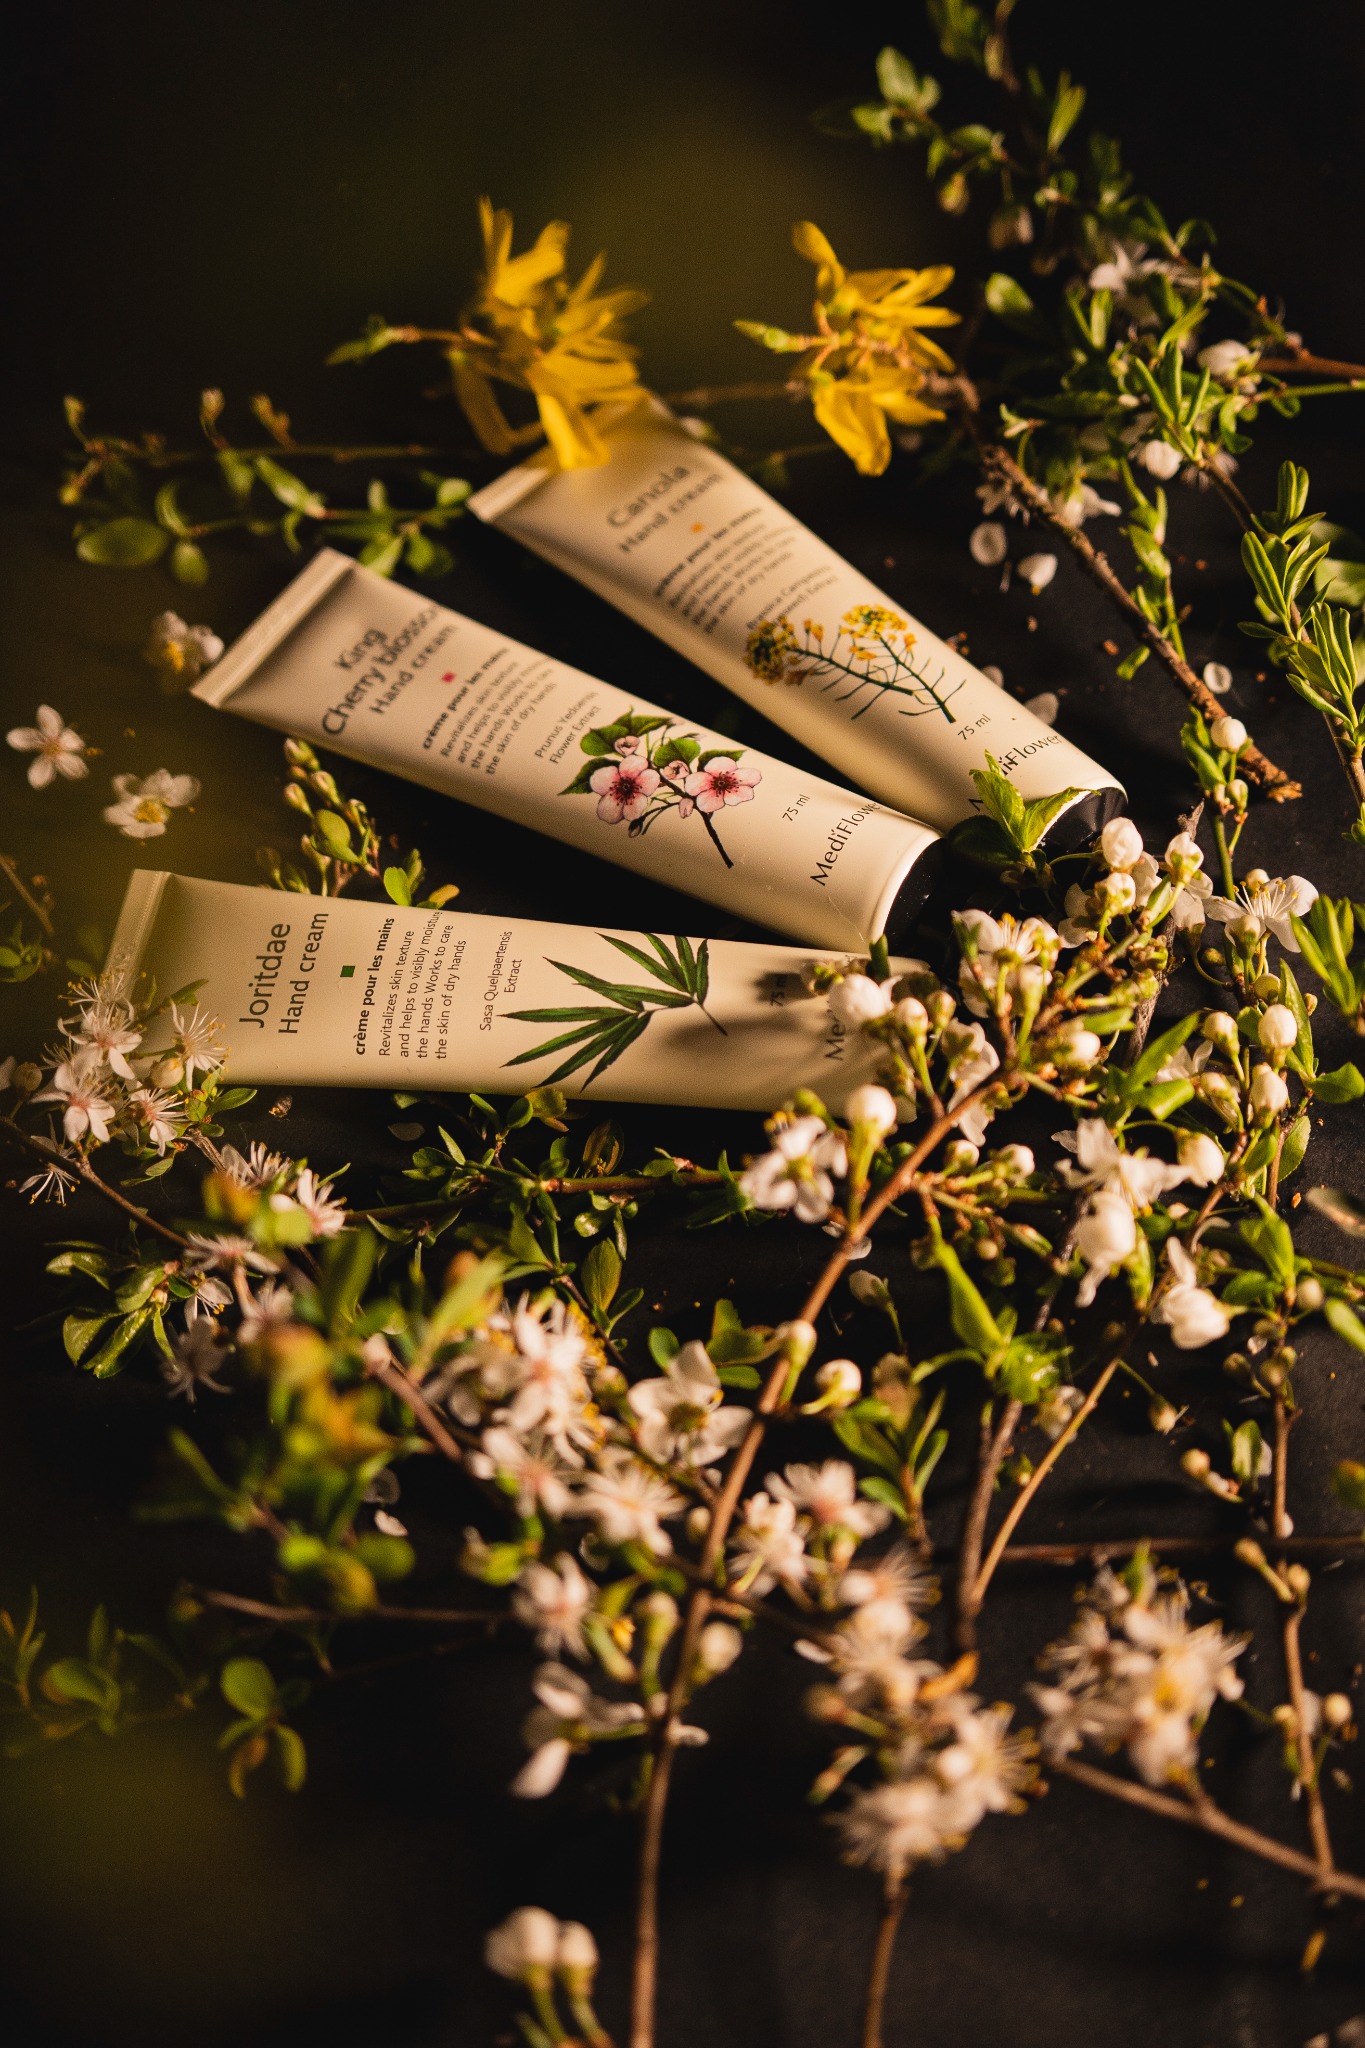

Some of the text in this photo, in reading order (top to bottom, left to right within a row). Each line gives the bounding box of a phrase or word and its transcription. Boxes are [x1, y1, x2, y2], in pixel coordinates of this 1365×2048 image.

[606, 466, 691, 527] Canola
[618, 473, 723, 553] Hand cream
[334, 629, 388, 671] King
[369, 625, 458, 714] Hand cream
[322, 666, 386, 735] Cherry
[447, 686, 469, 712] pour
[457, 740, 473, 763] and
[466, 713, 491, 739] helps
[470, 749, 486, 769] the
[480, 718, 506, 747] hands
[485, 755, 501, 775] the
[496, 732, 514, 753] skin
[511, 719, 522, 732] of
[519, 705, 536, 720] dry
[534, 725, 564, 758] Prunus
[549, 731, 576, 764] Flower
[957, 713, 991, 740] 75 ml
[782, 794, 810, 821] 75 ml
[810, 803, 880, 886] MediFlowe
[239, 923, 291, 1029] Joritdae
[278, 913, 329, 1033] Hand cream
[353, 917, 395, 1055] crème pour les mains
[407, 982, 419, 994] to
[410, 947, 430, 981] visibly
[479, 931, 513, 1031] Sasa Quelpaertensis
[504, 959, 522, 993] Extract
[378, 930, 415, 1056] Revitalizes skin texture
[399, 997, 417, 1029] helps
[416, 925, 454, 1059] the hands Works to care
[434, 940, 467, 1059] the skin of dry hands
[770, 990, 785, 1007] 75
[398, 1033, 410, 1058] and
